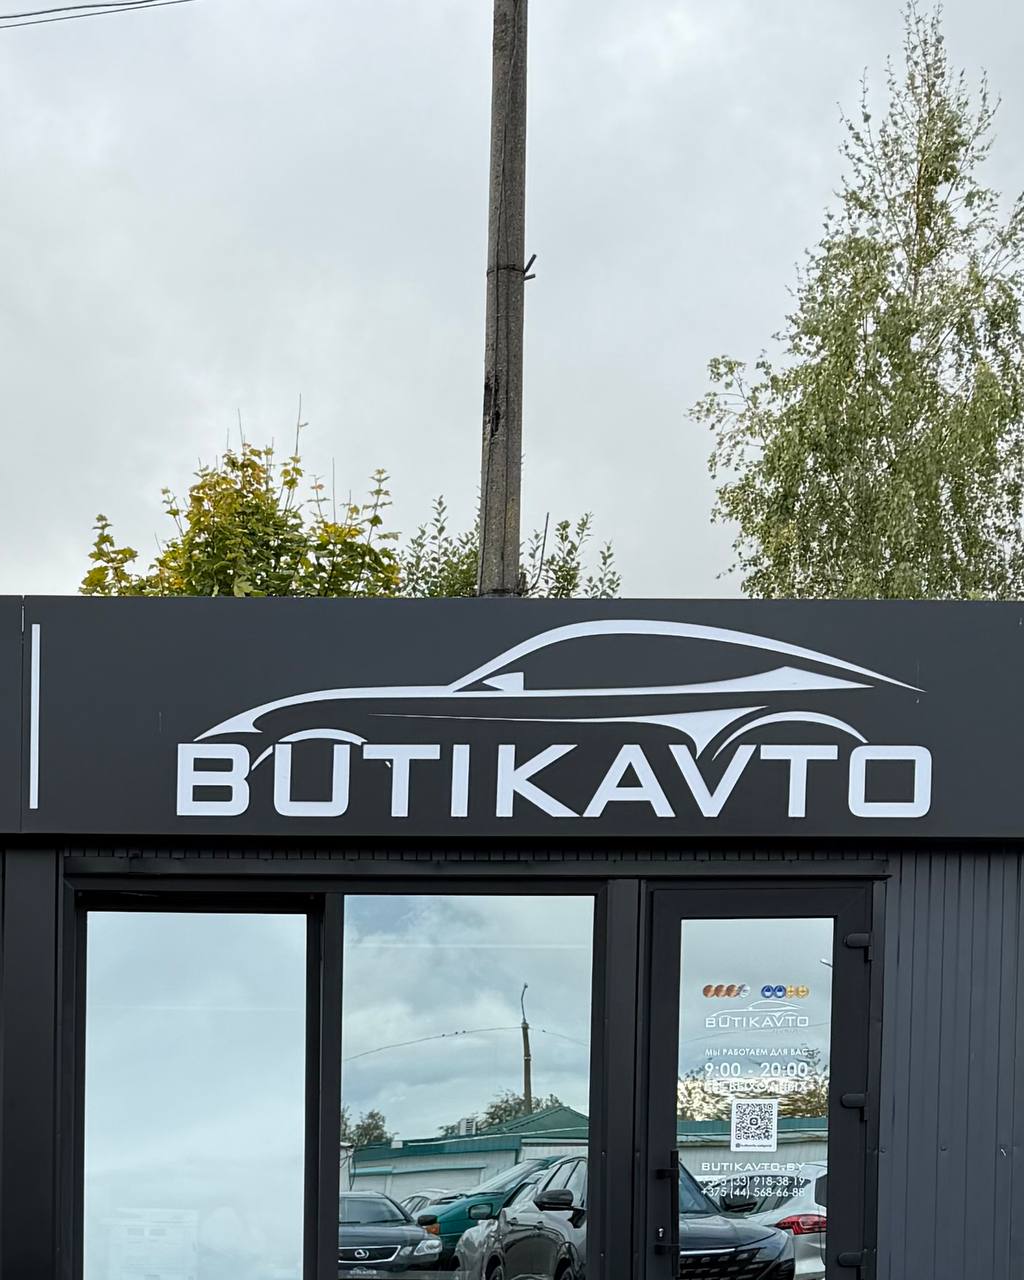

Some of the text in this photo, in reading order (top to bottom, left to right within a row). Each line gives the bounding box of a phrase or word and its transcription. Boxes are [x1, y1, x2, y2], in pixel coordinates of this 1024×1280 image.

[175, 742, 933, 820] BUTIKAVTO
[705, 1016, 809, 1028] BUTIKAVTO
[704, 1048, 808, 1057] МЫ РАБОТАЕМ ДЛЯ ВАС
[704, 1062, 741, 1077] 9:00
[760, 1062, 808, 1077] 20:00
[701, 1162, 805, 1171] BUTIKAVTO.BY
[730, 1176, 750, 1188] (33)
[753, 1176, 805, 1186] 918-38-19
[701, 1187, 805, 1199] +375 (44) 568-66-88
